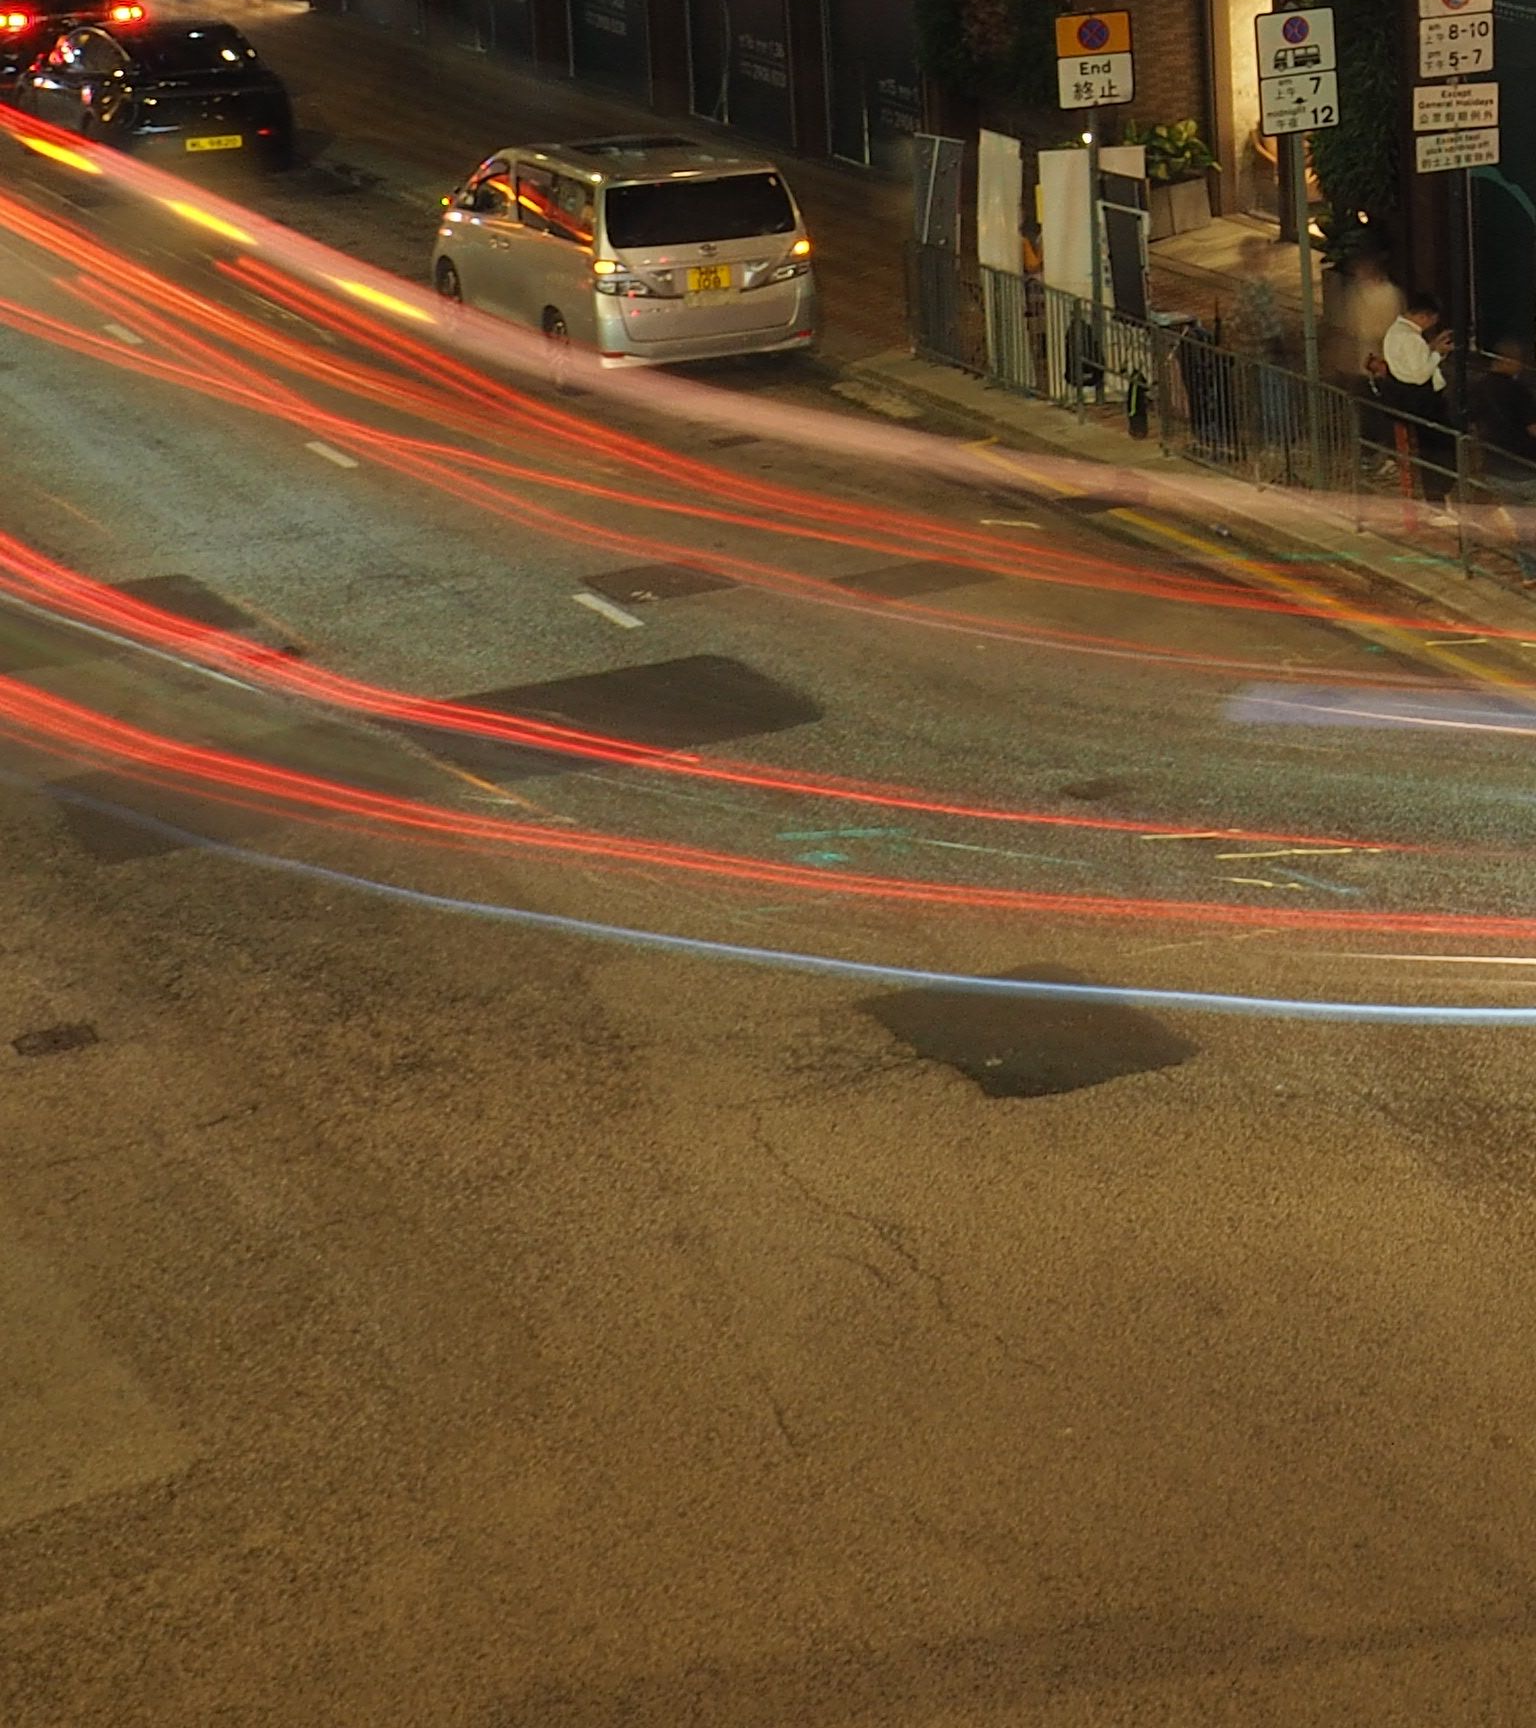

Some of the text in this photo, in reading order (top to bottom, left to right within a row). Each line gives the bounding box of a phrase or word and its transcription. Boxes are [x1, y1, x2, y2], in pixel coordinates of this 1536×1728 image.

[1448, 21, 1489, 40] 8-10
[1079, 59, 1111, 76] End
[1073, 79, 1120, 101] 終止
[1309, 76, 1321, 95] 7
[1441, 89, 1472, 100] Except
[1455, 98, 1494, 108] Holidays
[1311, 105, 1333, 125] 12
